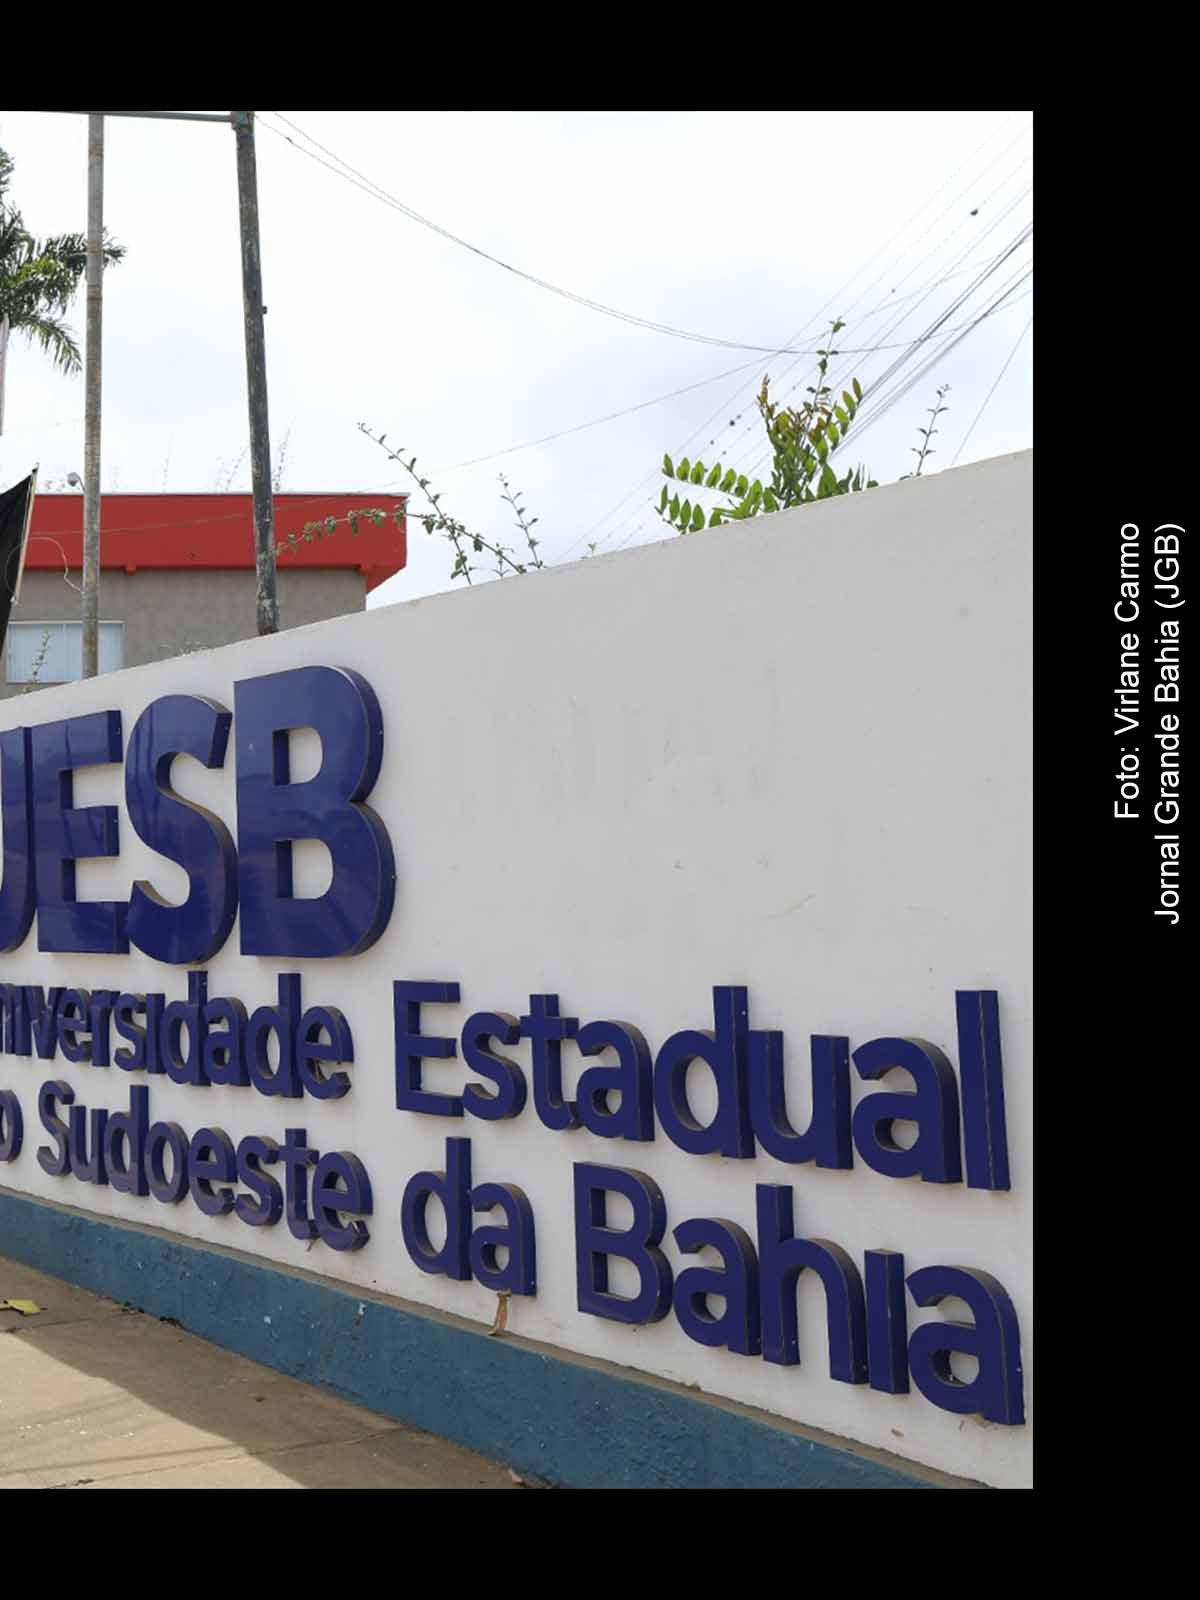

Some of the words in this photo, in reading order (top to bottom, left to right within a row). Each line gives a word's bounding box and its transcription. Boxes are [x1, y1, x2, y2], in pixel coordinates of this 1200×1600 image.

[393, 980, 1011, 1191] Estadual
[37, 1080, 373, 1252] Sudoeste
[401, 1137, 537, 1297] da
[573, 1162, 1026, 1426] Bahia
